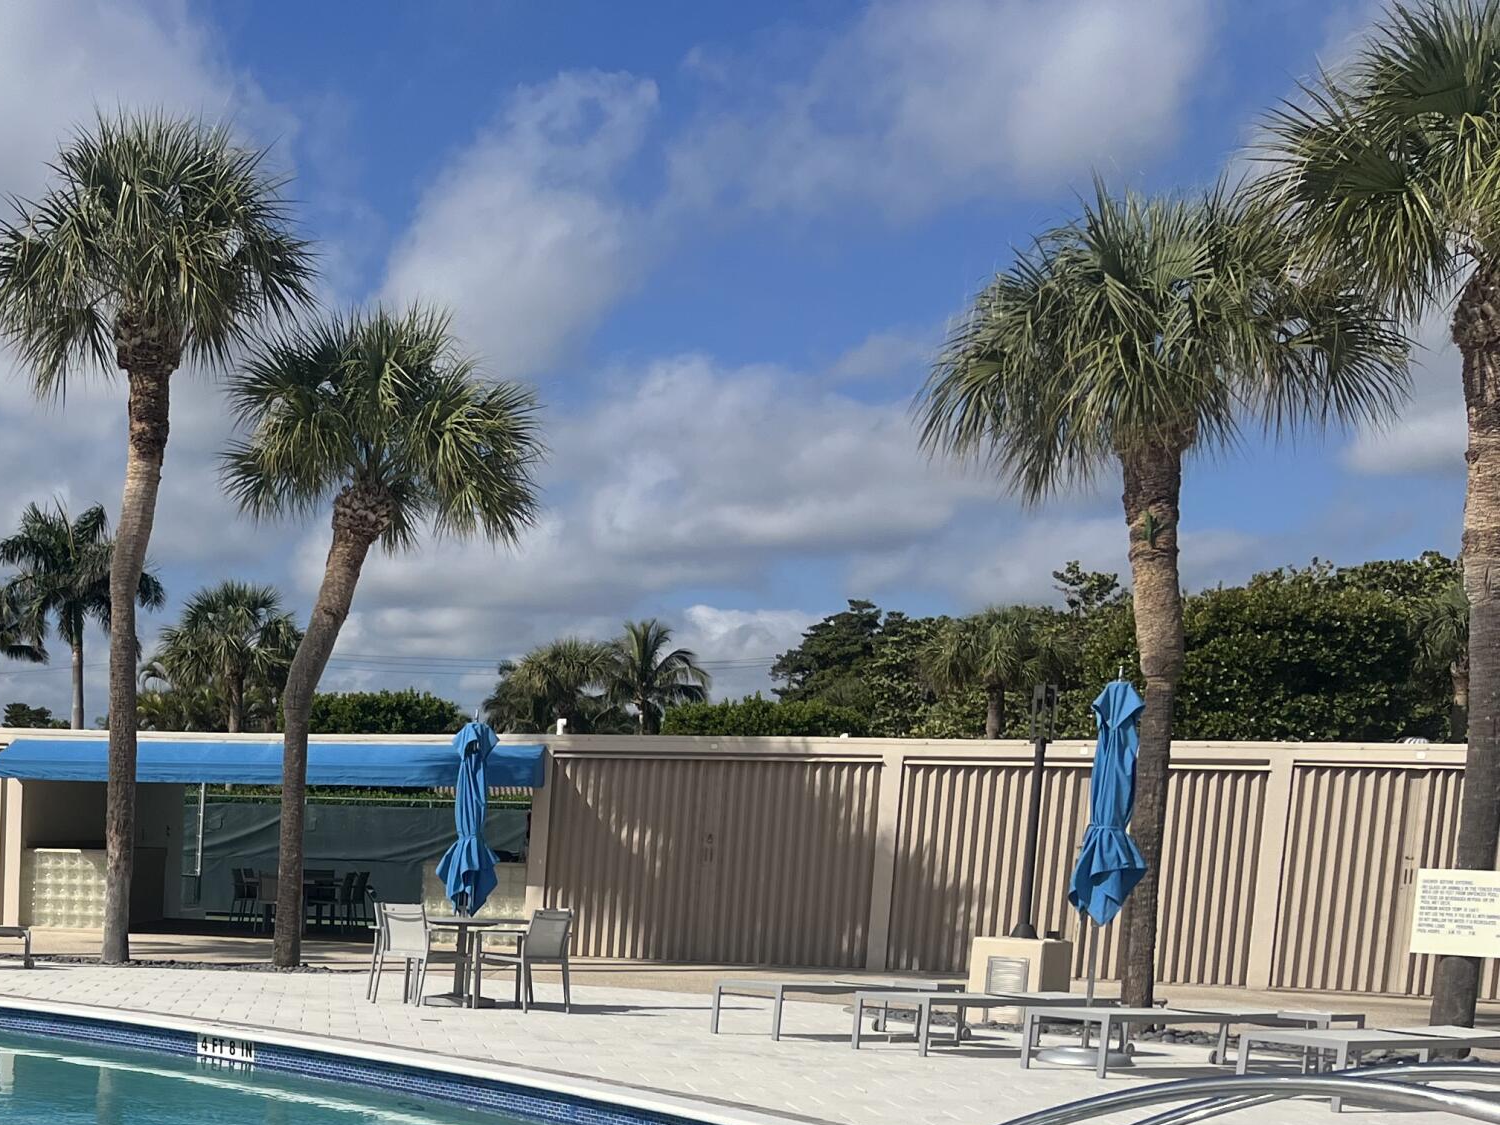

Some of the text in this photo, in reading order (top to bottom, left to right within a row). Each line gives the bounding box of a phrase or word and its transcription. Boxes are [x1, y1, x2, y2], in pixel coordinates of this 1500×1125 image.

[201, 1036, 253, 1058] 4 FT 8 IN
